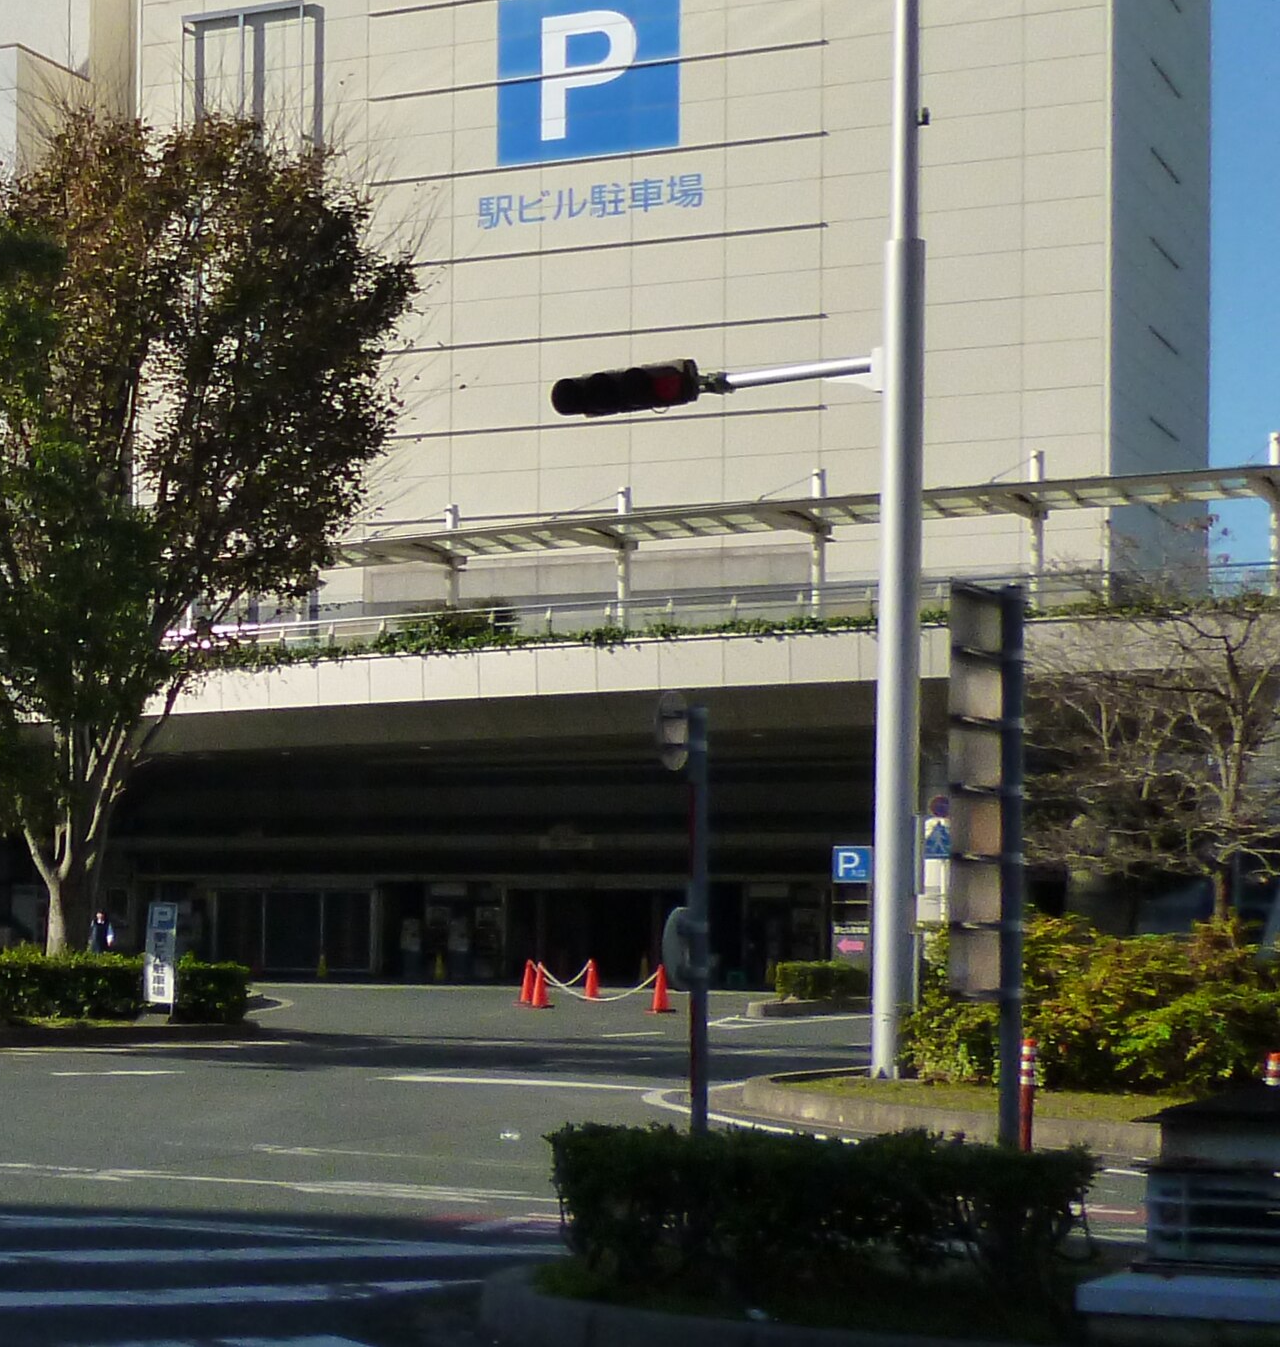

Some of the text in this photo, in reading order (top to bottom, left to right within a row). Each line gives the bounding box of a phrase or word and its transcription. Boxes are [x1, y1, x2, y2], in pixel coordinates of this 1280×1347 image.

[541, 9, 638, 141] P
[477, 173, 705, 230] 駅ビル駐車場
[838, 852, 860, 877] P
[152, 907, 171, 928] P
